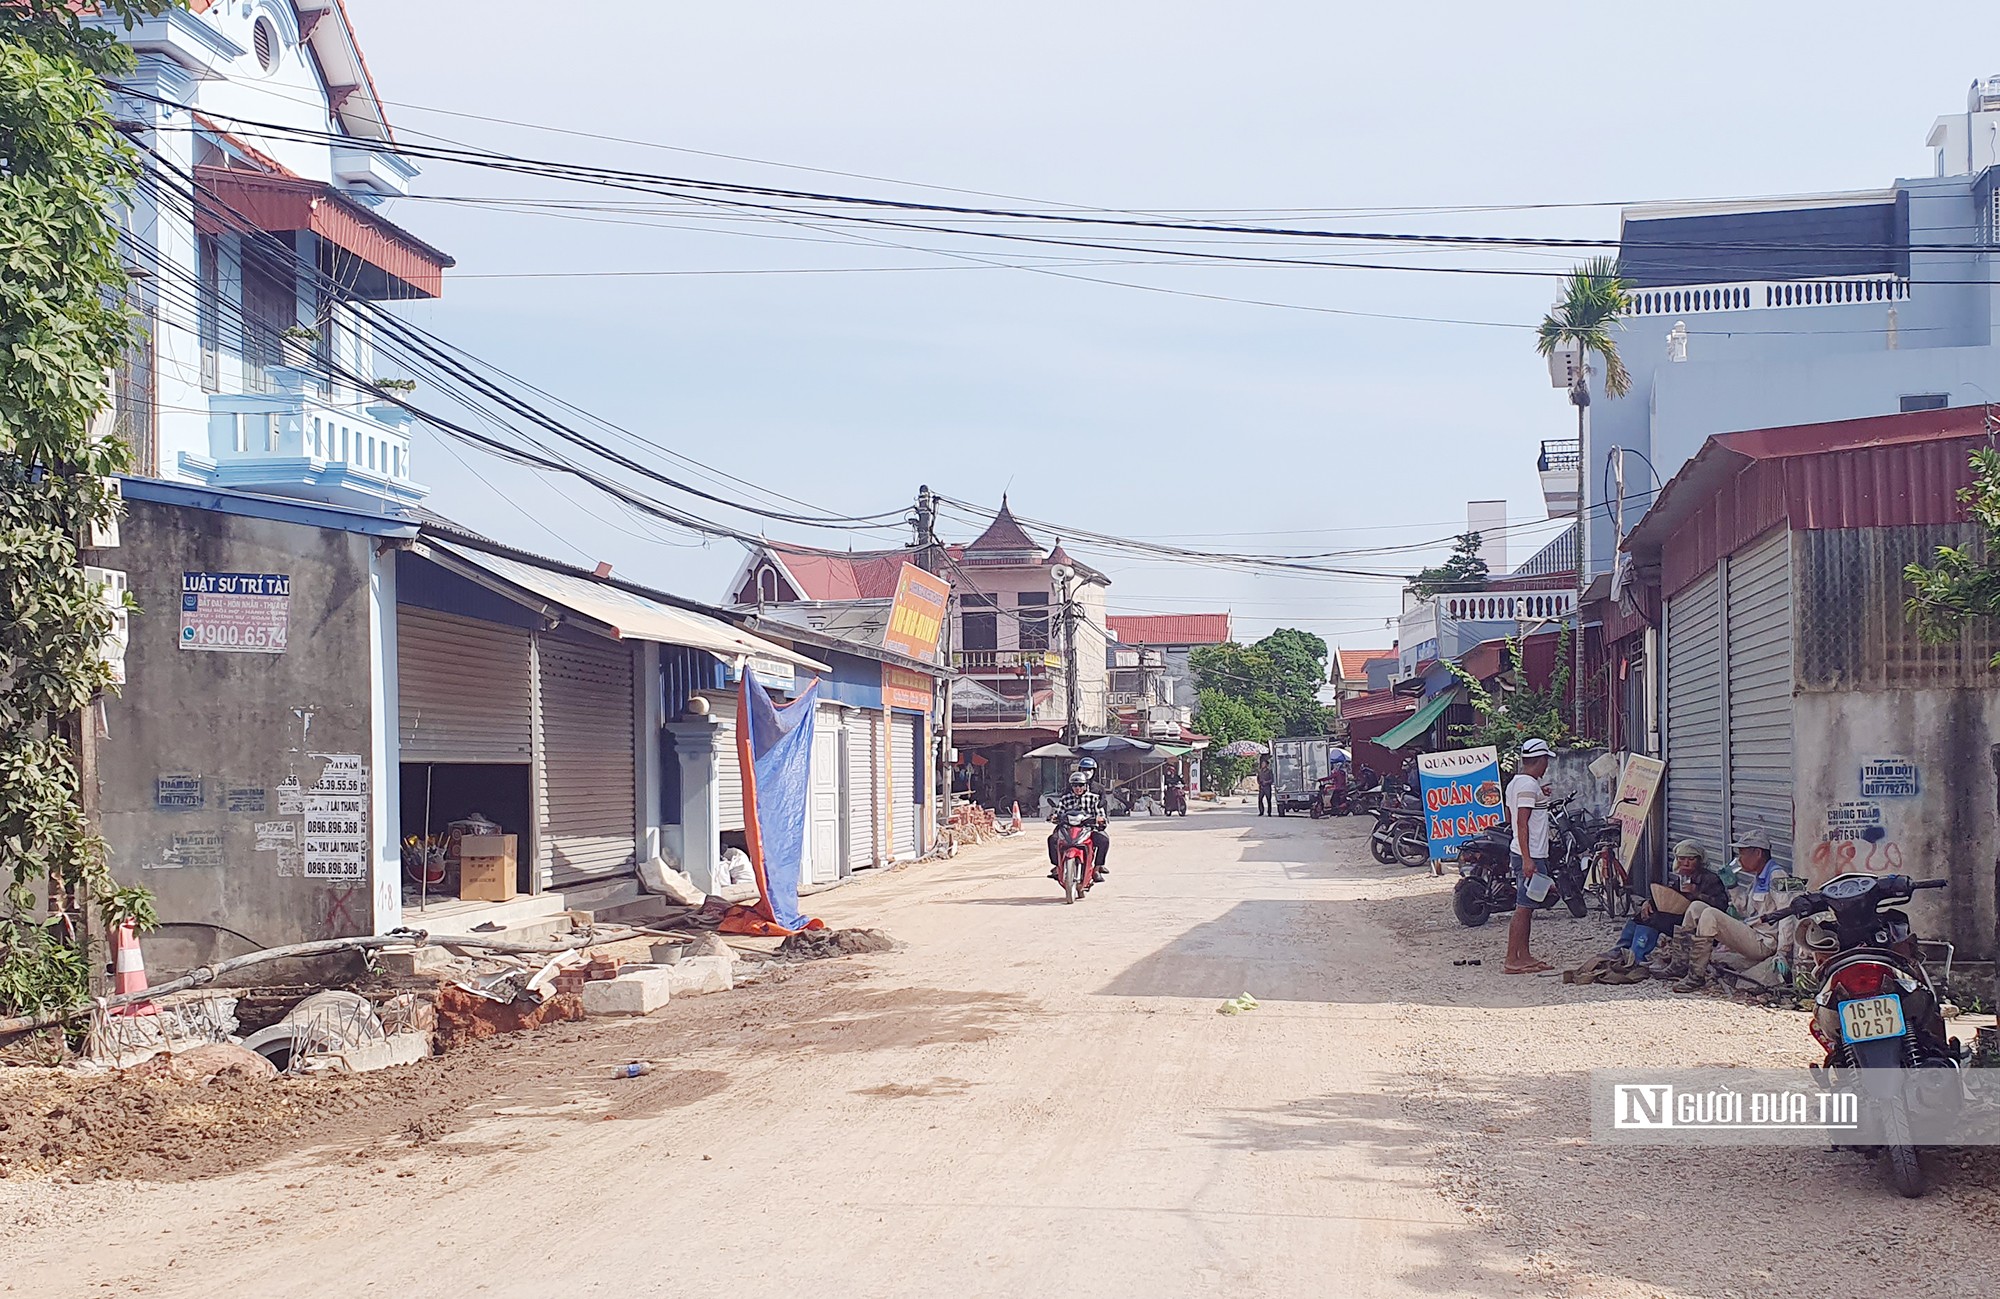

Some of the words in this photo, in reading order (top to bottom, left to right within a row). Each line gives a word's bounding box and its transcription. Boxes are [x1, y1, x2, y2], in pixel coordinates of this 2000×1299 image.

[182, 572, 216, 592] LUẬT
[218, 576, 238, 593] SƯ
[240, 574, 263, 594] TRÍ
[266, 575, 290, 595] TÀI
[196, 624, 287, 647] 1900.6574
[1426, 781, 1473, 812] QUÁN
[307, 821, 358, 834] 0896.896.368
[1431, 814, 1454, 840] ĂN
[307, 861, 358, 875] 0896.896.368
[1848, 1001, 1893, 1020] 16-R4
[1851, 1017, 1895, 1039] 0257
